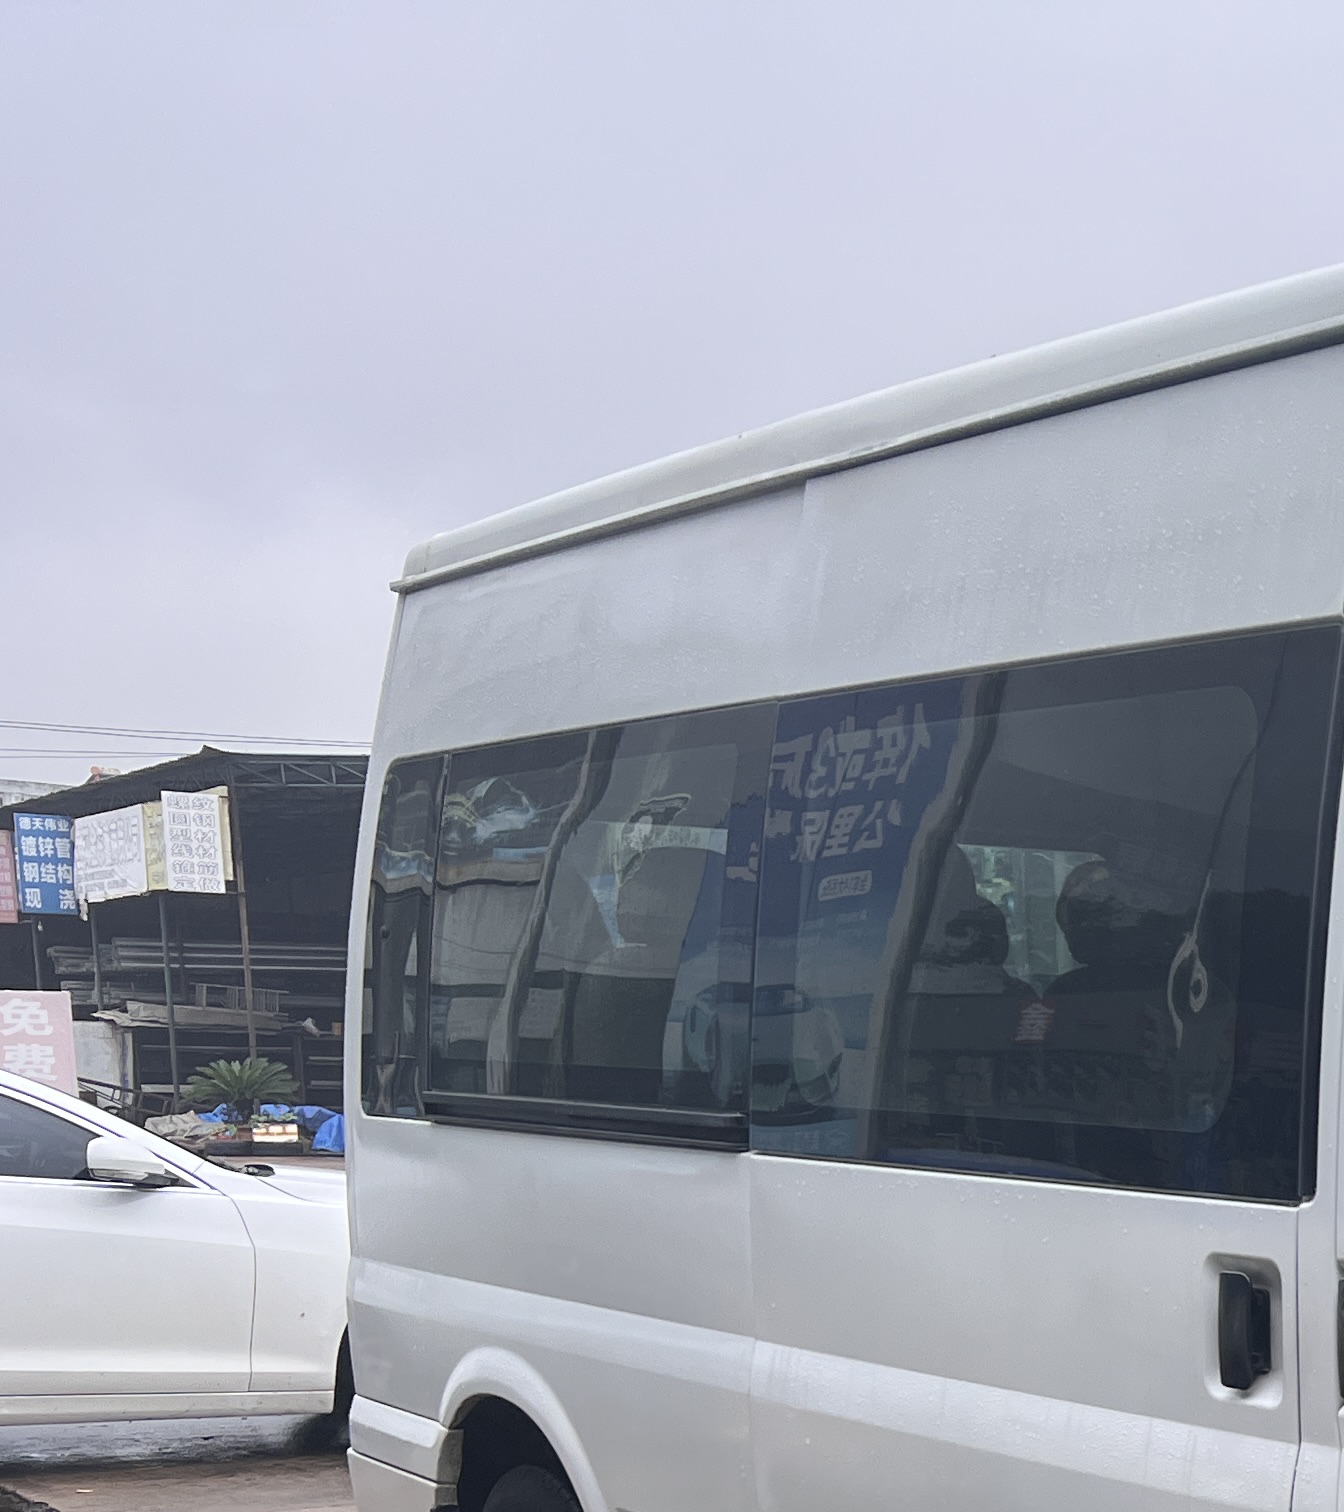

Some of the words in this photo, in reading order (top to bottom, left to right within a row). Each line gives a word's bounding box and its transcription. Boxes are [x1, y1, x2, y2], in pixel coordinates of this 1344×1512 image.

[167, 794, 215, 812] 螺纹
[19, 816, 70, 832] 德天伟业
[169, 827, 217, 844] 型材
[21, 835, 71, 859] 镀锌管
[171, 843, 218, 860] 线材
[23, 861, 73, 885] 钢结构
[173, 876, 221, 891] 定做
[0, 998, 58, 1080] 免费
